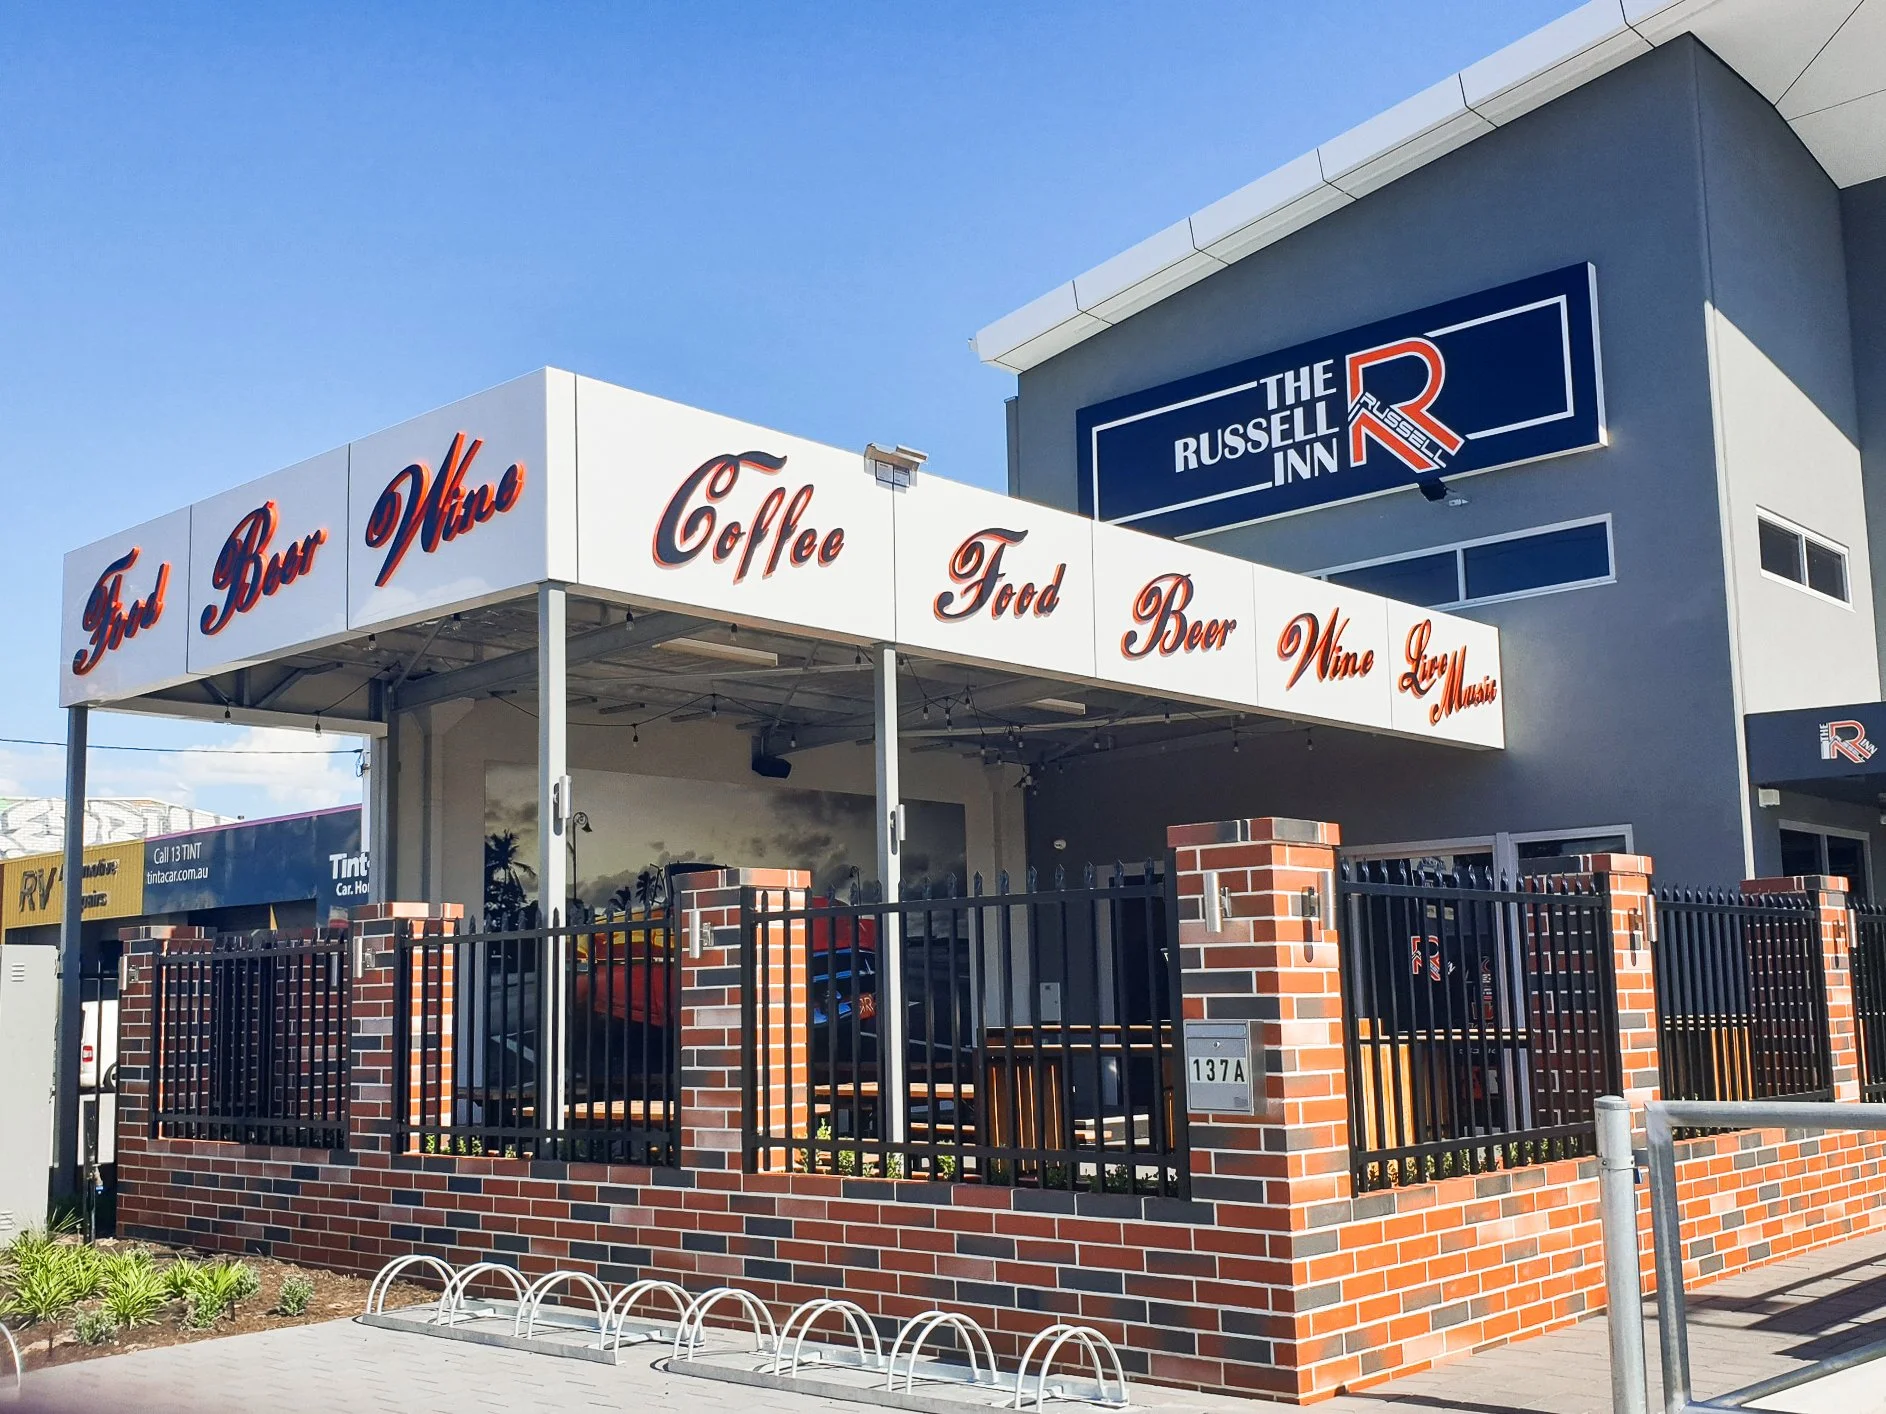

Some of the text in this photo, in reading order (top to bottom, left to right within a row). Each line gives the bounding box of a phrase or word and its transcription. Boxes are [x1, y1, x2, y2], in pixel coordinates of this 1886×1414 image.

[1261, 359, 1337, 411] THE
[1175, 402, 1339, 473] RUSSELL
[1360, 391, 1447, 468] RUSSELL
[1274, 438, 1339, 486] INN
[72, 432, 525, 676] Food Beer Wine
[652, 450, 1376, 691] Coffee Food Beer Wine
[1398, 619, 1448, 698] Live
[1429, 645, 1498, 726] Music
[147, 867, 209, 884] tintacar.com.au
[153, 842, 202, 865] Call 13 TINT
[329, 853, 370, 879] Tint
[19, 867, 58, 913] RV
[336, 880, 370, 897] Car. Ho
[1193, 1058, 1245, 1082] 137A
